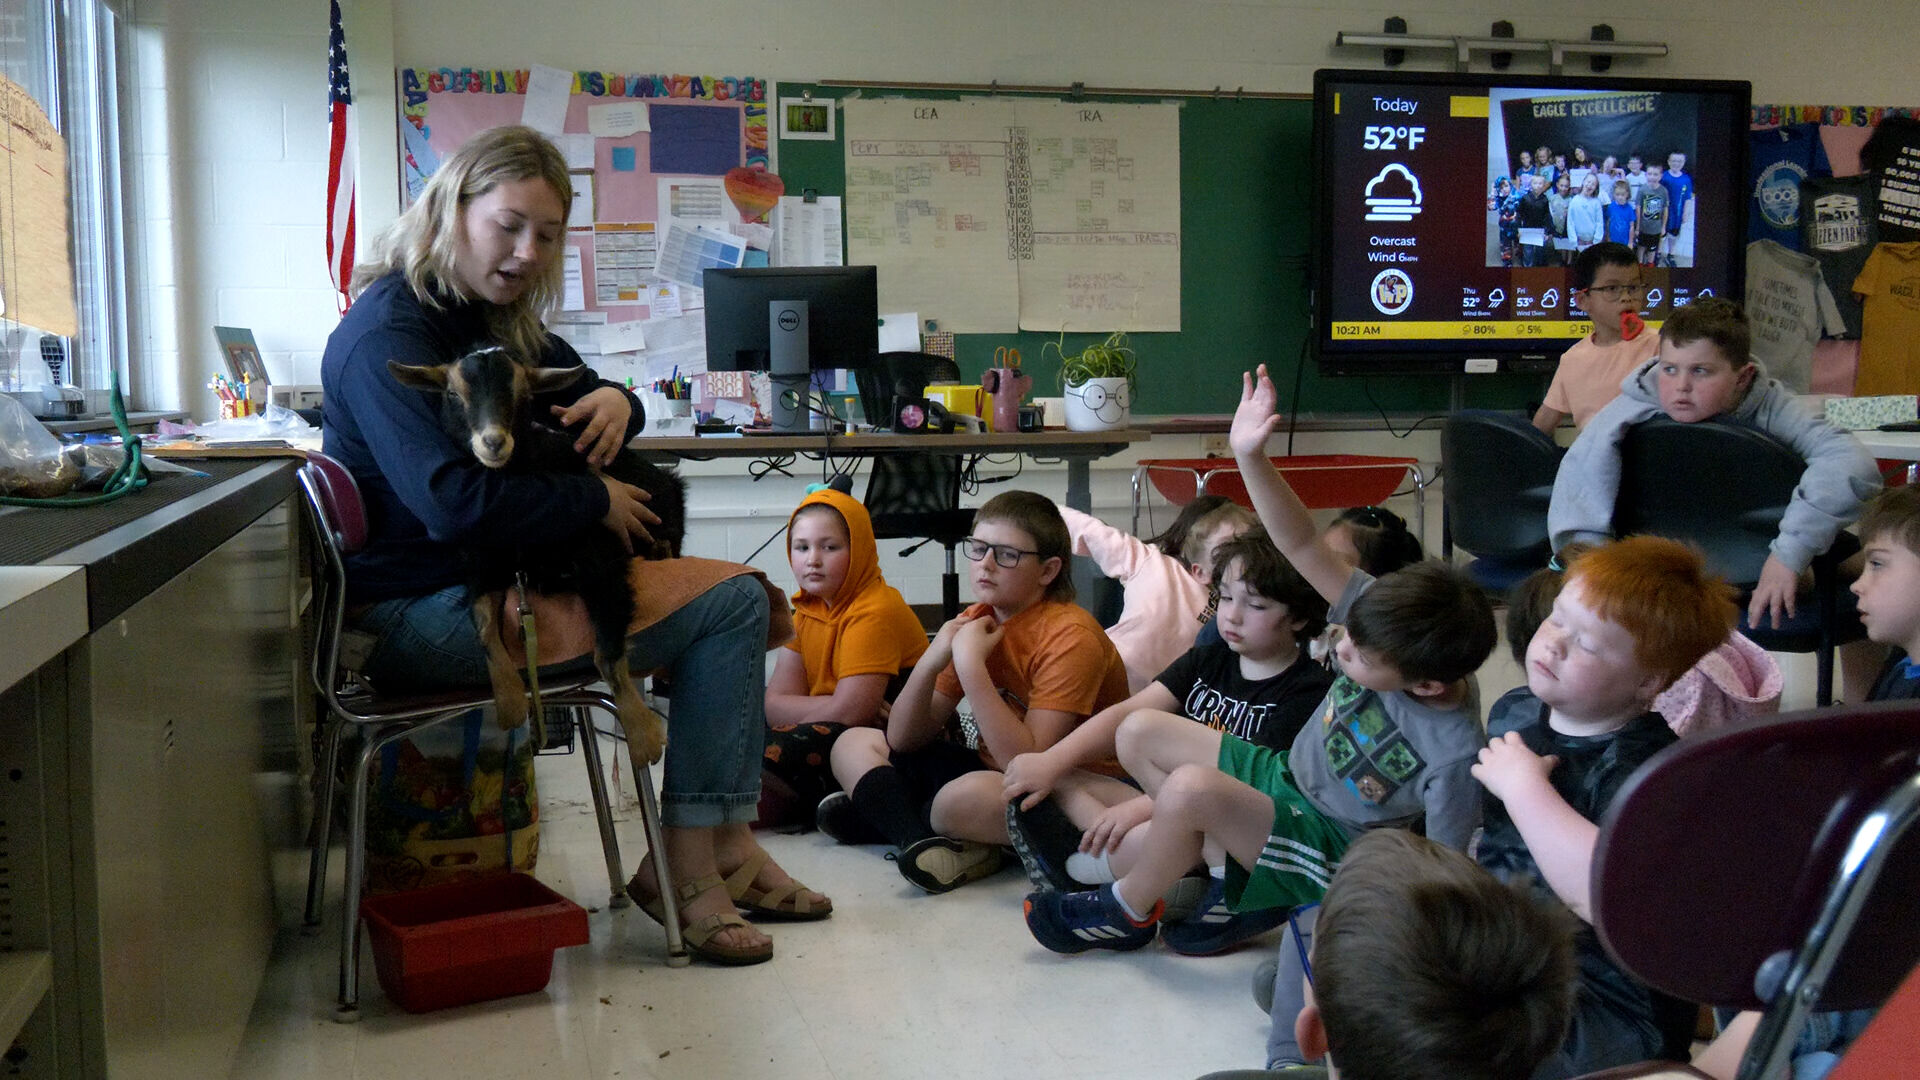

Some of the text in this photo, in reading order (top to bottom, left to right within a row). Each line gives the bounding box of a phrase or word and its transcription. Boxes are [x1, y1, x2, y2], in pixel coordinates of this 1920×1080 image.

[1372, 97, 1418, 115] Today
[1533, 96, 1656, 118] EAGLE EXCELLENCE
[914, 107, 938, 119] CEA
[1075, 109, 1103, 122] TRA
[1363, 126, 1426, 150] 52°F
[1370, 236, 1416, 246] Overcast
[1367, 252, 1396, 262] Wind
[1463, 287, 1476, 295] Thu
[1516, 287, 1526, 295] Fri
[1463, 297, 1481, 307] 52°
[1516, 297, 1534, 307] 53°
[1335, 325, 1381, 335] 10:21 AM
[1473, 325, 1496, 335] 80%
[1527, 325, 1542, 335] 5%
[1184, 677, 1278, 740] ORTNIT
